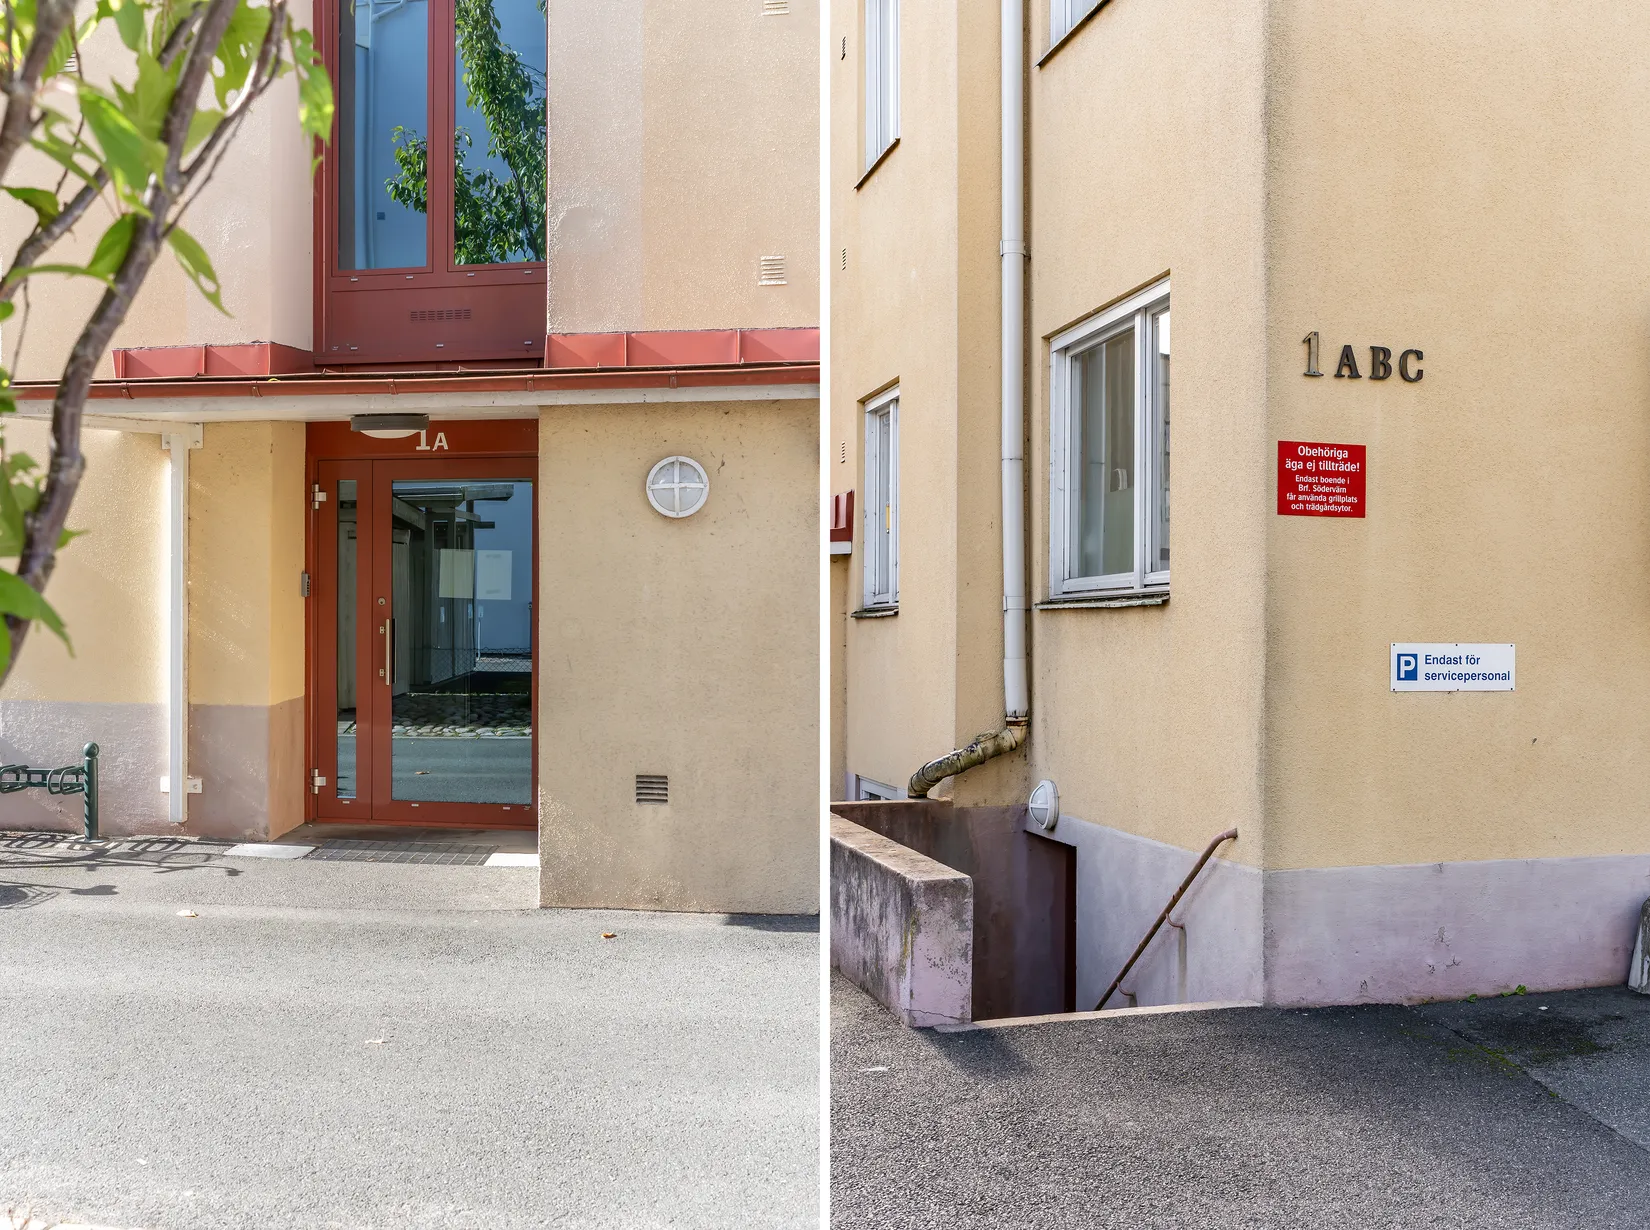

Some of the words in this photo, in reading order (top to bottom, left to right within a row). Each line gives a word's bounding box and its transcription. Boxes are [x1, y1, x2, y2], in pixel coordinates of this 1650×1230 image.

[1302, 331, 1324, 377] 1
[1297, 445, 1349, 460] Obehöriga
[1285, 458, 1304, 471] äga
[1306, 460, 1316, 472] ej
[1318, 461, 1360, 472] tillträde!
[1295, 474, 1319, 483] Endast
[1319, 475, 1346, 484] boende
[1298, 484, 1311, 492] Brf.
[1312, 484, 1347, 493] Södervärn
[1286, 492, 1296, 501] får
[1297, 494, 1327, 502] använda
[1328, 495, 1358, 504] grillplats
[1305, 503, 1353, 513] trädgårdsytor.
[1424, 654, 1463, 665] Endast
[1465, 654, 1481, 665] för
[1400, 656, 1416, 679] P
[1424, 670, 1511, 684] servicepersonal
